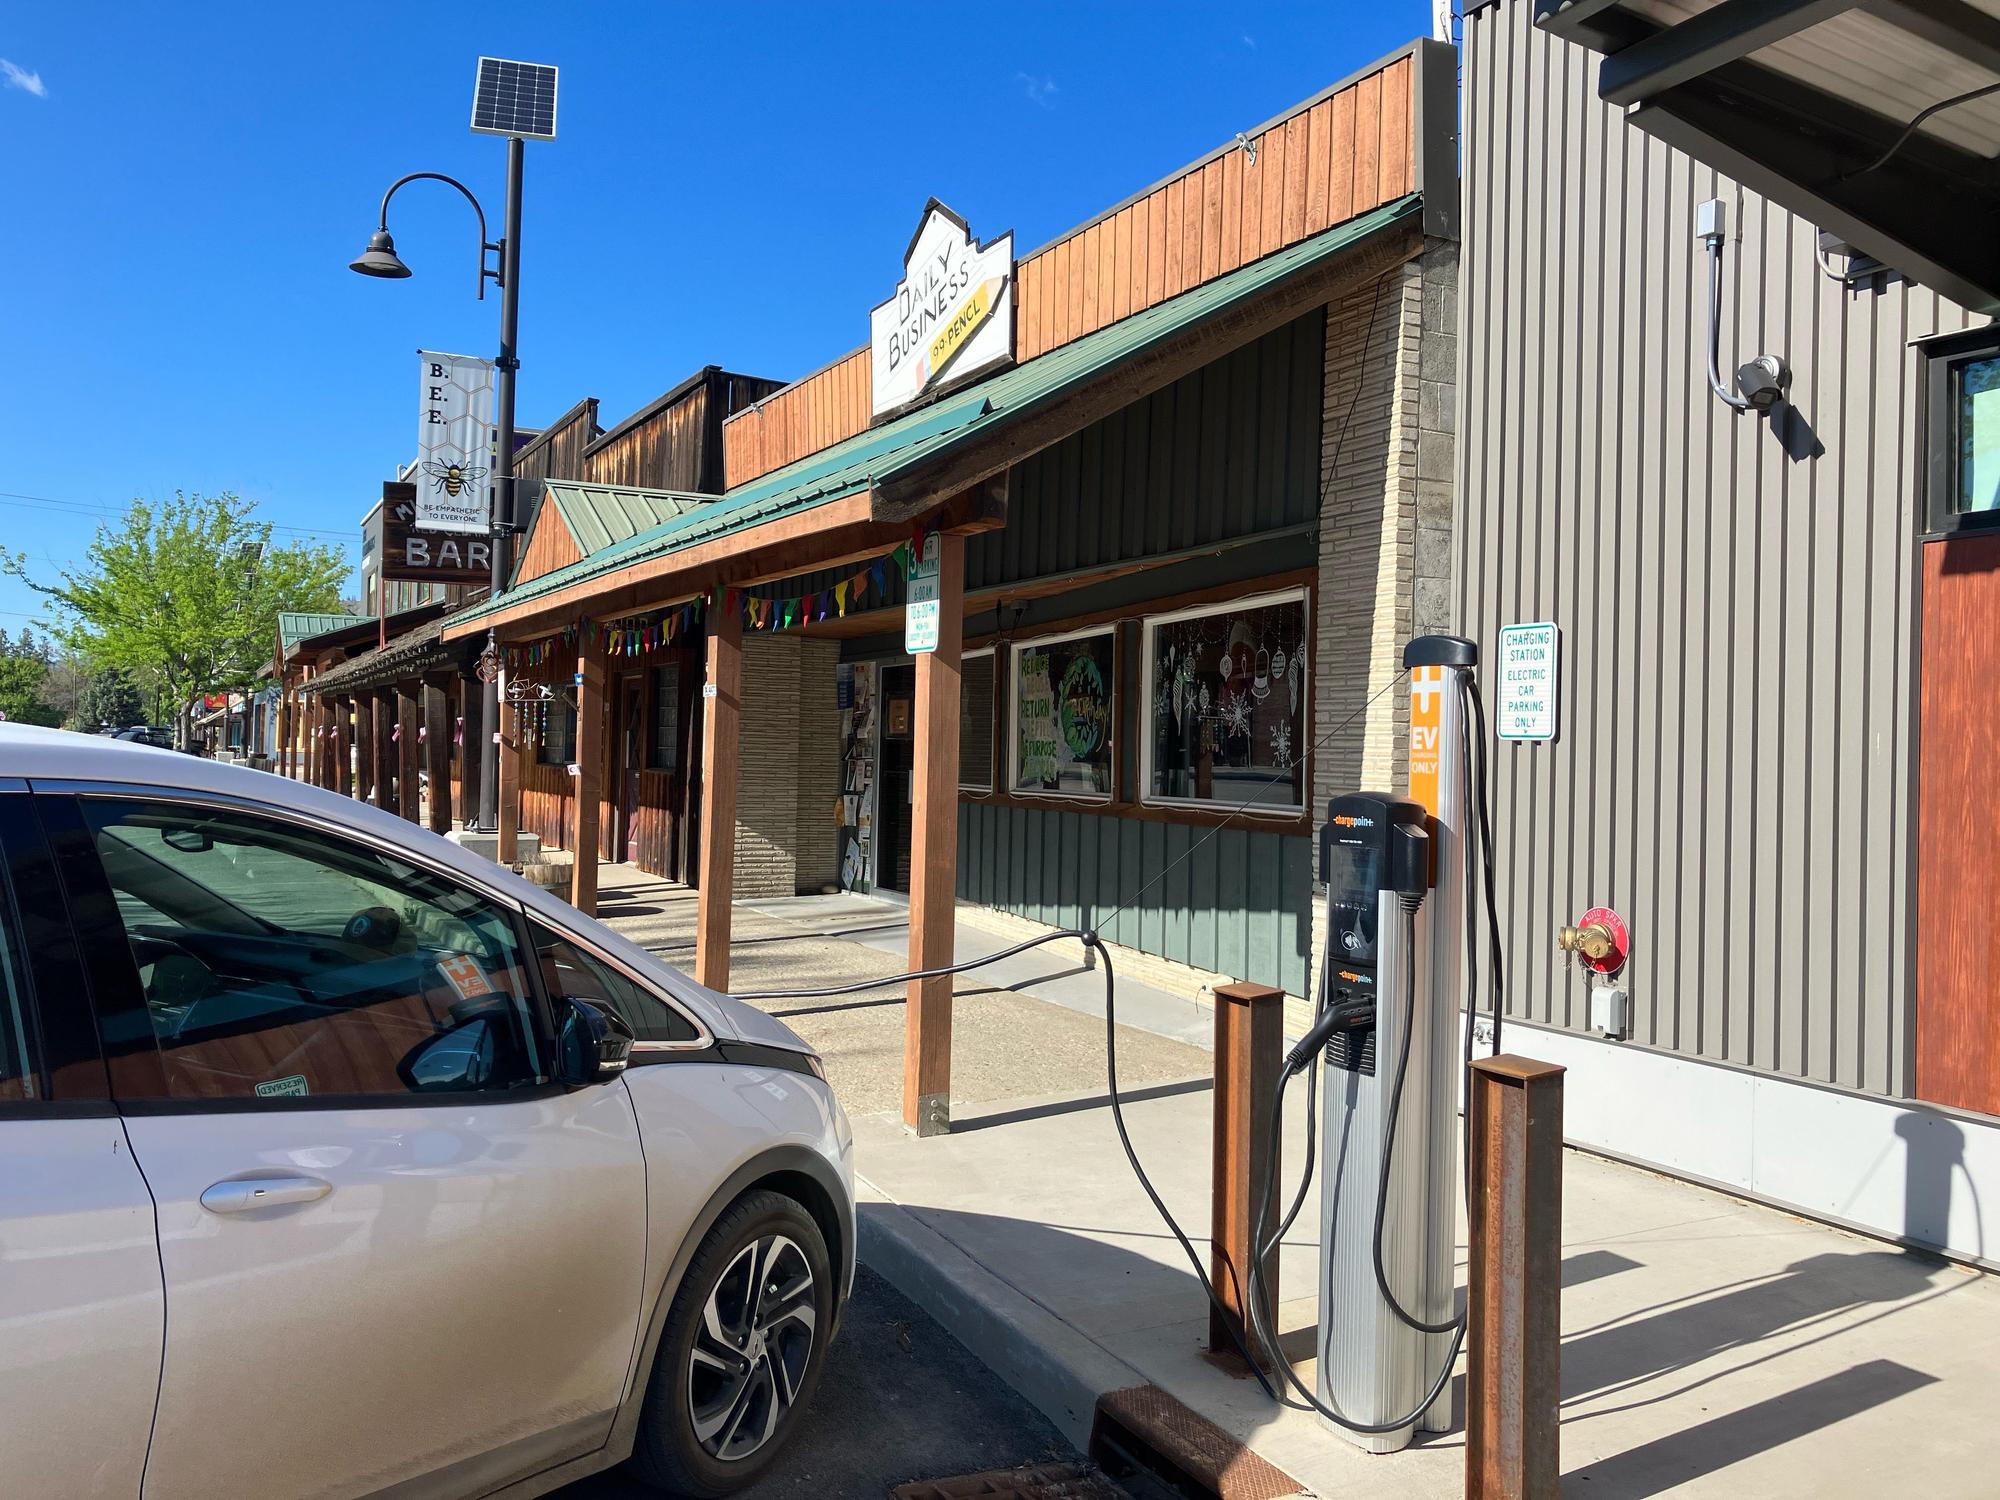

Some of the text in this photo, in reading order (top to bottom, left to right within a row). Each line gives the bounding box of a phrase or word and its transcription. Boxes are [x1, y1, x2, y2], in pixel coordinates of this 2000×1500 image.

[899, 240, 953, 326] DAILY
[889, 261, 969, 373] BUSINESS
[440, 513, 478, 523] EVERYONE
[406, 537, 491, 570] BAR
[1506, 631, 1550, 646] CHARGING
[1510, 648, 1545, 661] STATION
[1507, 669, 1546, 681] ELECTRIC
[1518, 685, 1535, 696] CAR
[1021, 697, 1050, 719] RETURN
[1508, 701, 1544, 712] PARKING
[1514, 717, 1536, 728] ONLY
[1412, 726, 1438, 749] EV
[1411, 761, 1438, 774] ONLY
[1585, 909, 1602, 922] AUTO
